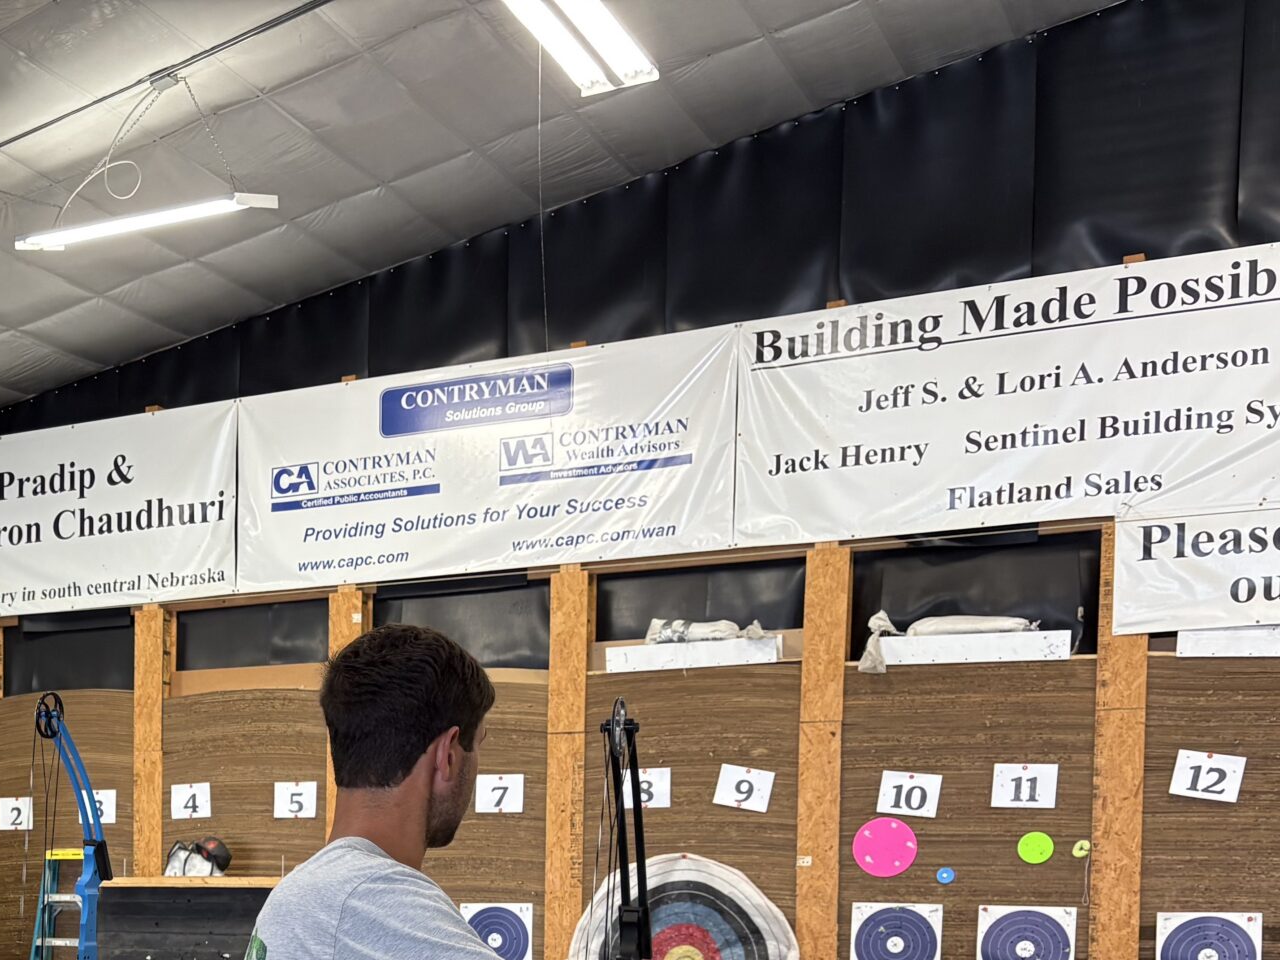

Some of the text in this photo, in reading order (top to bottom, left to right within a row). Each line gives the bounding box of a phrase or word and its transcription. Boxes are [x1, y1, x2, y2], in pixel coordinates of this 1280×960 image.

[752, 313, 944, 365] Building
[958, 286, 1097, 336] Made
[400, 373, 550, 410] CONTRYMAN
[857, 346, 1270, 414] Jeff S. & Lori A. Anderson
[445, 400, 545, 422] Solutions Group
[560, 417, 690, 447] CONTRYMAN
[965, 419, 1086, 454] Sentinel
[1097, 405, 1234, 440] Building
[322, 448, 437, 475] CONTRYMAN
[566, 438, 681, 461] Wealth Advisors
[768, 439, 930, 478] Jack Henry
[106, 454, 135, 486] &
[272, 467, 317, 495] CA
[323, 466, 436, 492] ASSOCIATES, P.C.
[550, 461, 638, 480] Investment Advisors
[301, 488, 408, 508] Certified Public Accountants
[946, 470, 1163, 511] Flatland Sales
[52, 490, 225, 541] Chaudhuri
[303, 493, 648, 544] Providing Solutions for Your Success
[297, 523, 677, 573] www.capc.com www.capc.com/wan
[22, 587, 37, 602] in
[41, 581, 83, 600] south
[87, 576, 142, 596] central
[147, 568, 225, 591] Nebraska
[639, 779, 654, 804] 8
[734, 779, 754, 804] 9
[1009, 775, 1040, 803] 11
[1186, 763, 1227, 796] 12
[183, 793, 199, 813] 4
[288, 791, 305, 814] 5
[491, 786, 509, 808] 7
[890, 784, 928, 811] 10
[10, 807, 23, 826] 2
